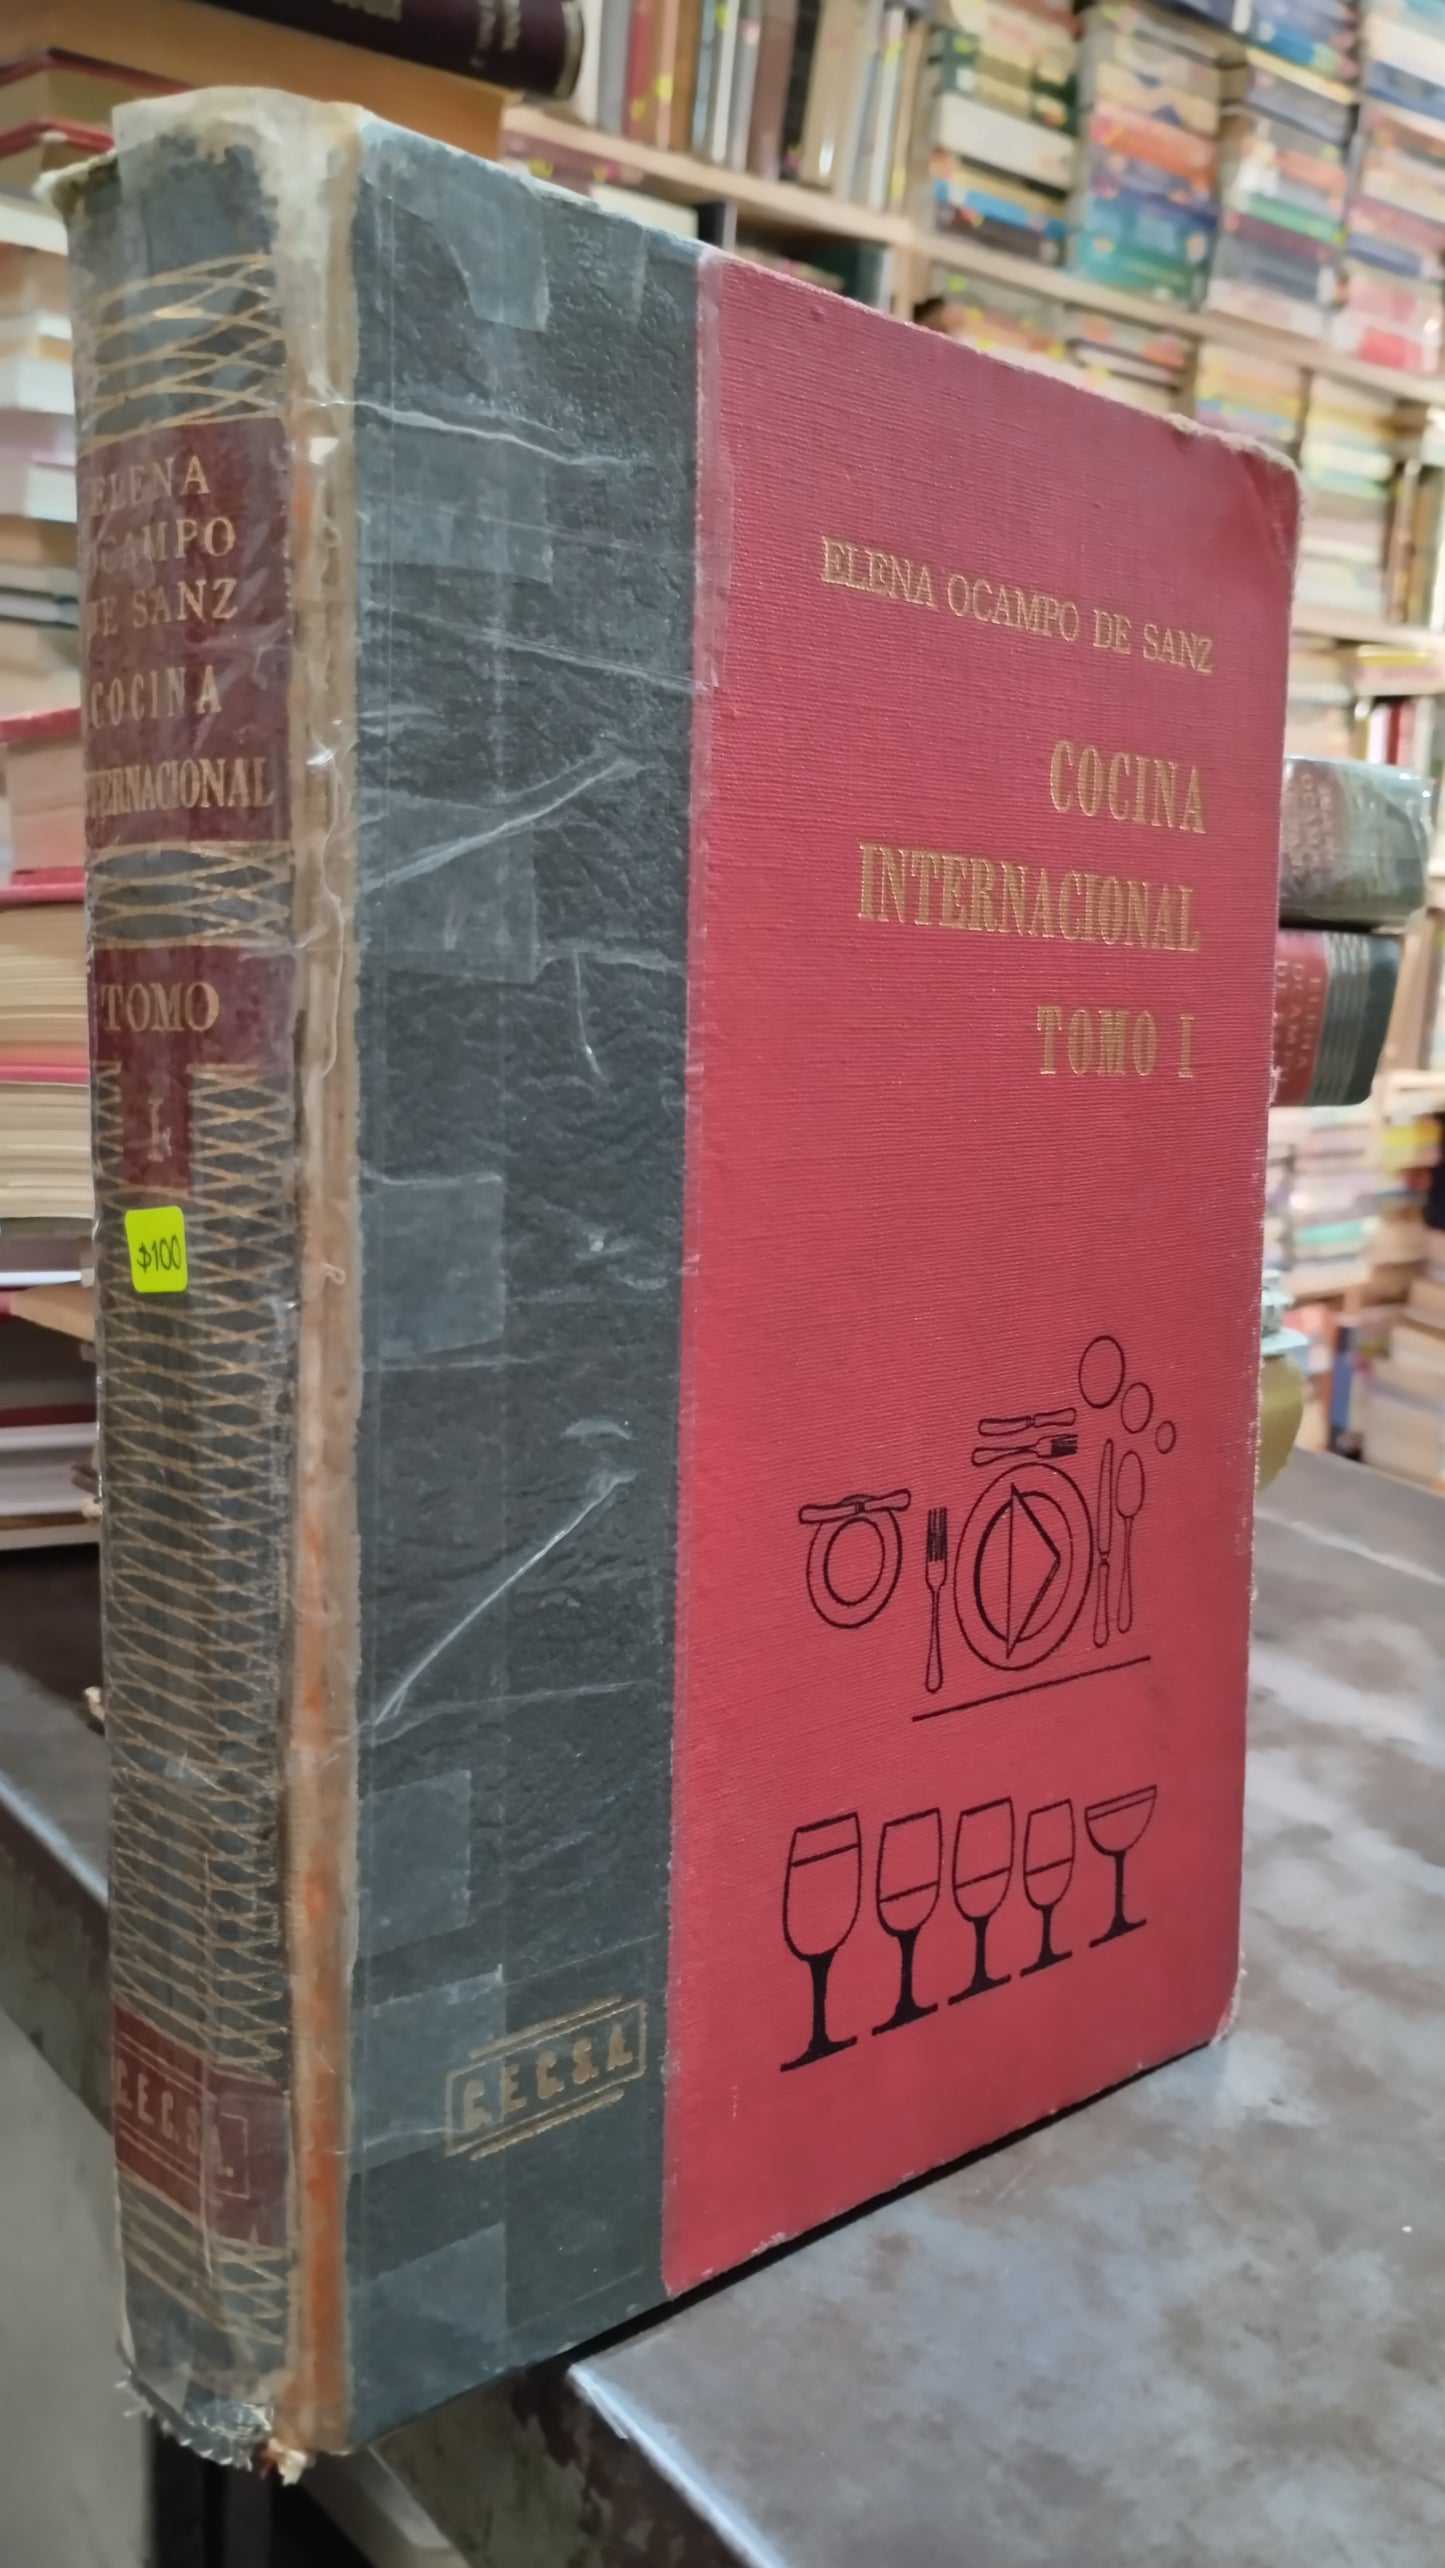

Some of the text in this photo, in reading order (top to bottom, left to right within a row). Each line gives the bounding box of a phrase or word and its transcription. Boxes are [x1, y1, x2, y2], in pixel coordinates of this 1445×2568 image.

[132, 577, 239, 629] SANZ
[821, 535, 1213, 674] ELENA OCAMPO DE SANZ
[90, 664, 222, 730] COCINA
[1049, 739, 1206, 833] COCINA
[857, 841, 1199, 952] INTERNACIONAL
[101, 981, 220, 1032] TOMO
[1036, 1004, 1158, 1077] TOMO
[1177, 1014, 1194, 1079] I
[148, 1098, 164, 1163] I
[137, 1234, 182, 1273] $100
